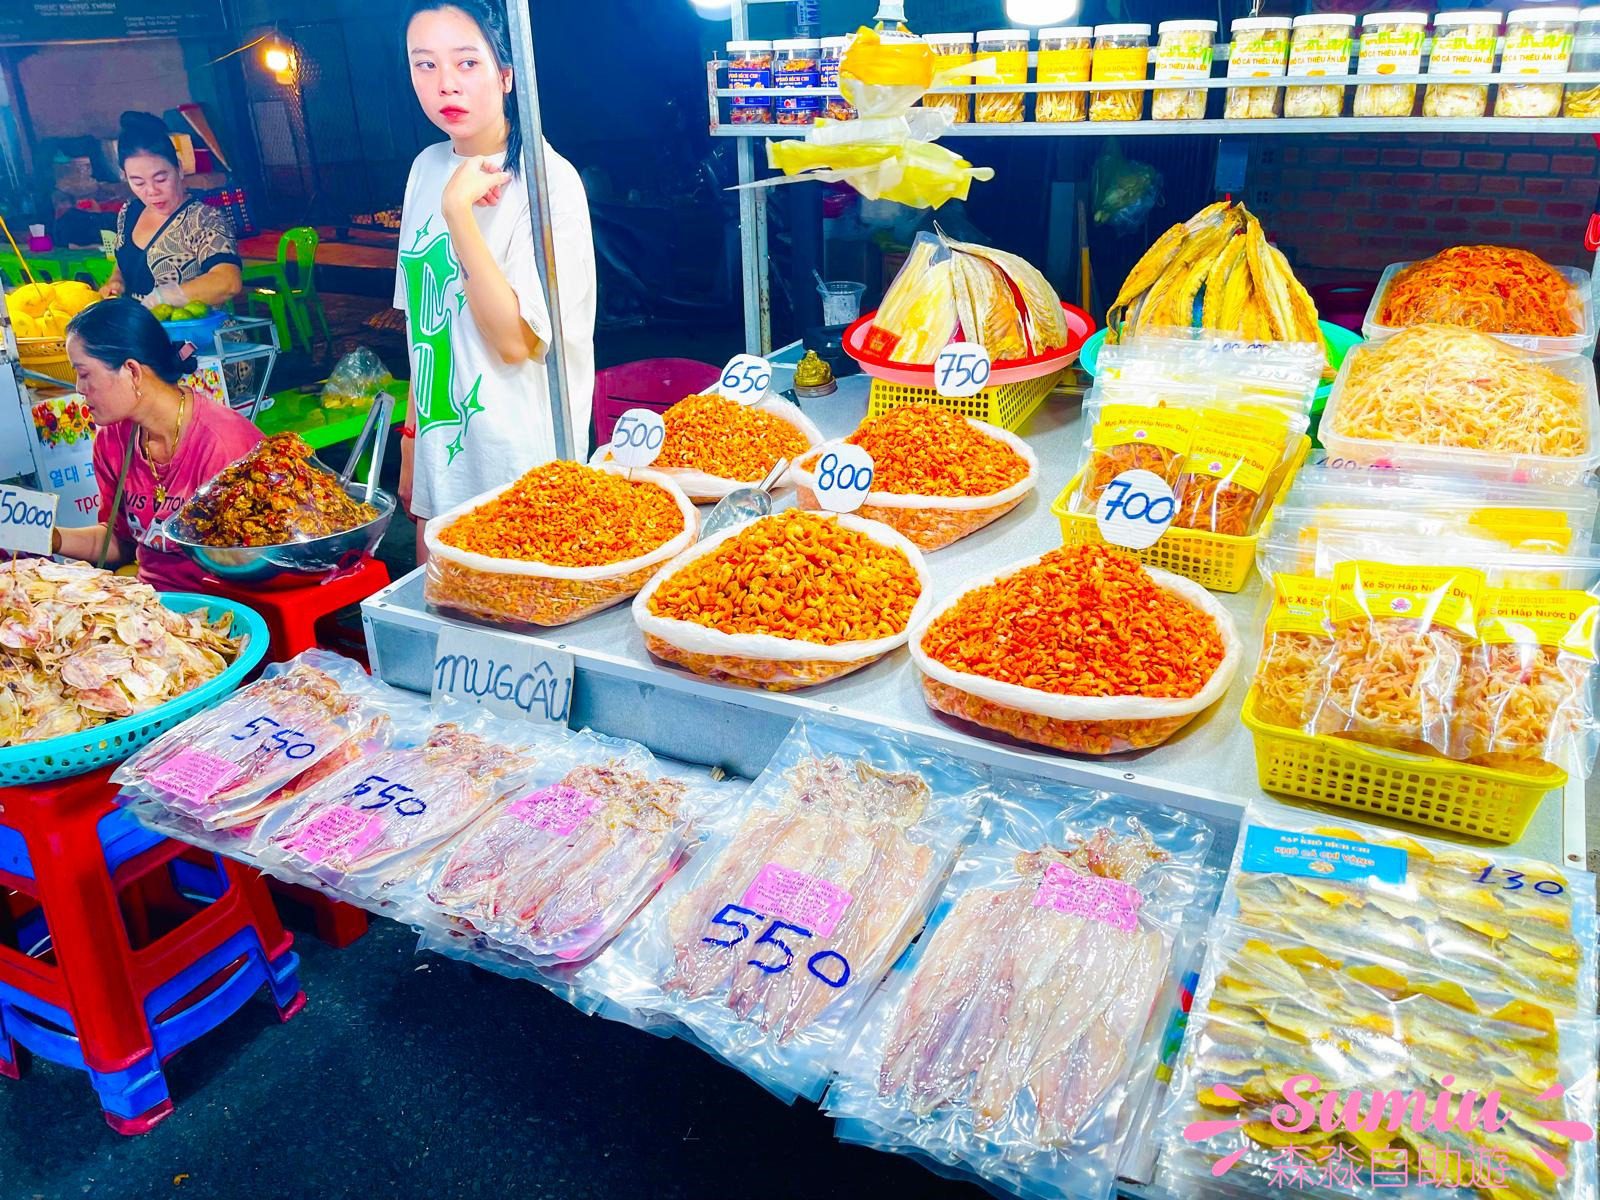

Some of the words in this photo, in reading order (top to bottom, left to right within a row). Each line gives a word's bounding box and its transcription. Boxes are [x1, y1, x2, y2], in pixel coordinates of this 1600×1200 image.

[722, 358, 771, 394] 650
[940, 353, 990, 387] 750
[613, 416, 664, 450] 500
[49, 464, 80, 489] 열대
[818, 452, 873, 492] 800
[0, 489, 53, 529] 50.000
[1104, 479, 1175, 524] 700
[231, 716, 316, 759] 550
[353, 775, 427, 816] 550
[1472, 863, 1564, 895] 130
[702, 903, 851, 988] 550
